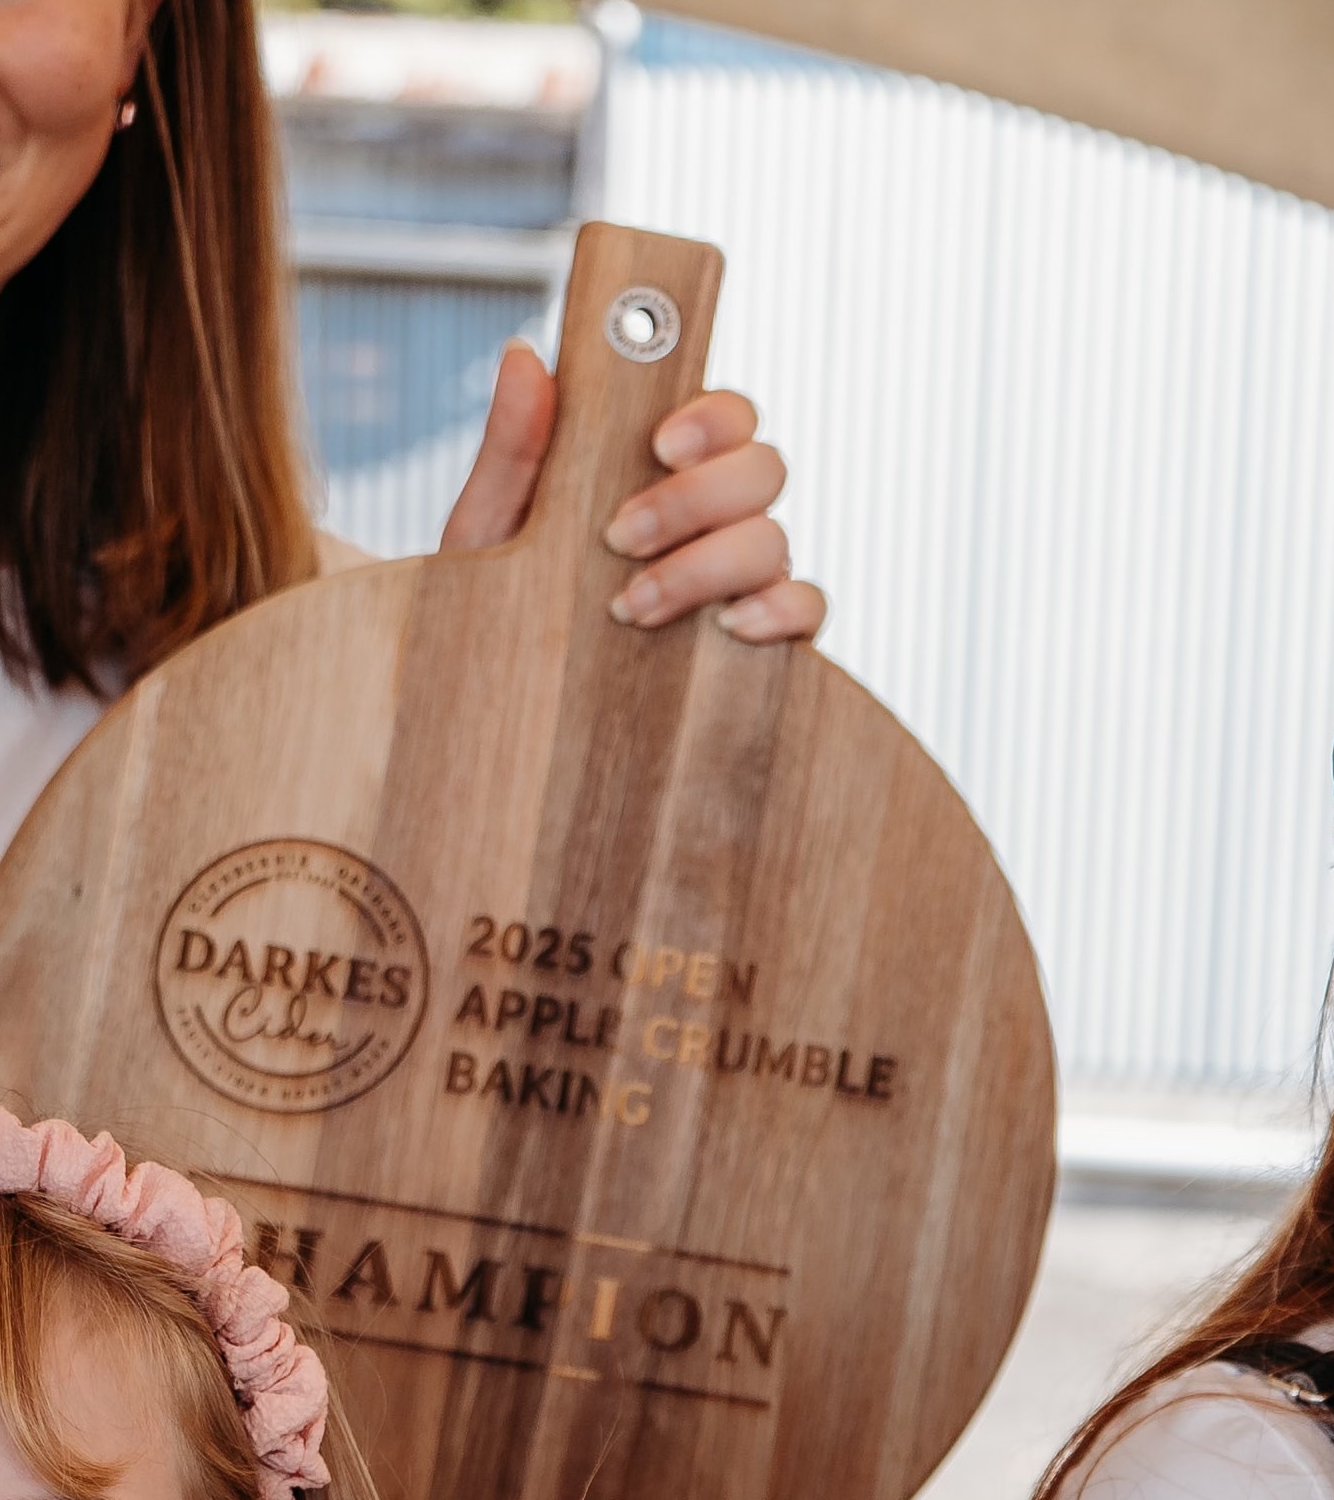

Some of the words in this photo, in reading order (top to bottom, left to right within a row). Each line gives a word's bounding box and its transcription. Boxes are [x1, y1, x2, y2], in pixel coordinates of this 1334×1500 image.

[175, 927, 414, 1009] DARKES
[466, 913, 596, 977] 2025
[612, 937, 759, 1008] OPEN
[222, 985, 351, 1054] Cider
[454, 982, 624, 1050] APPLE
[641, 1016, 899, 1102] CRUMBLE
[443, 1050, 654, 1128] BAKING
[250, 1218, 789, 1369] HAMPION
